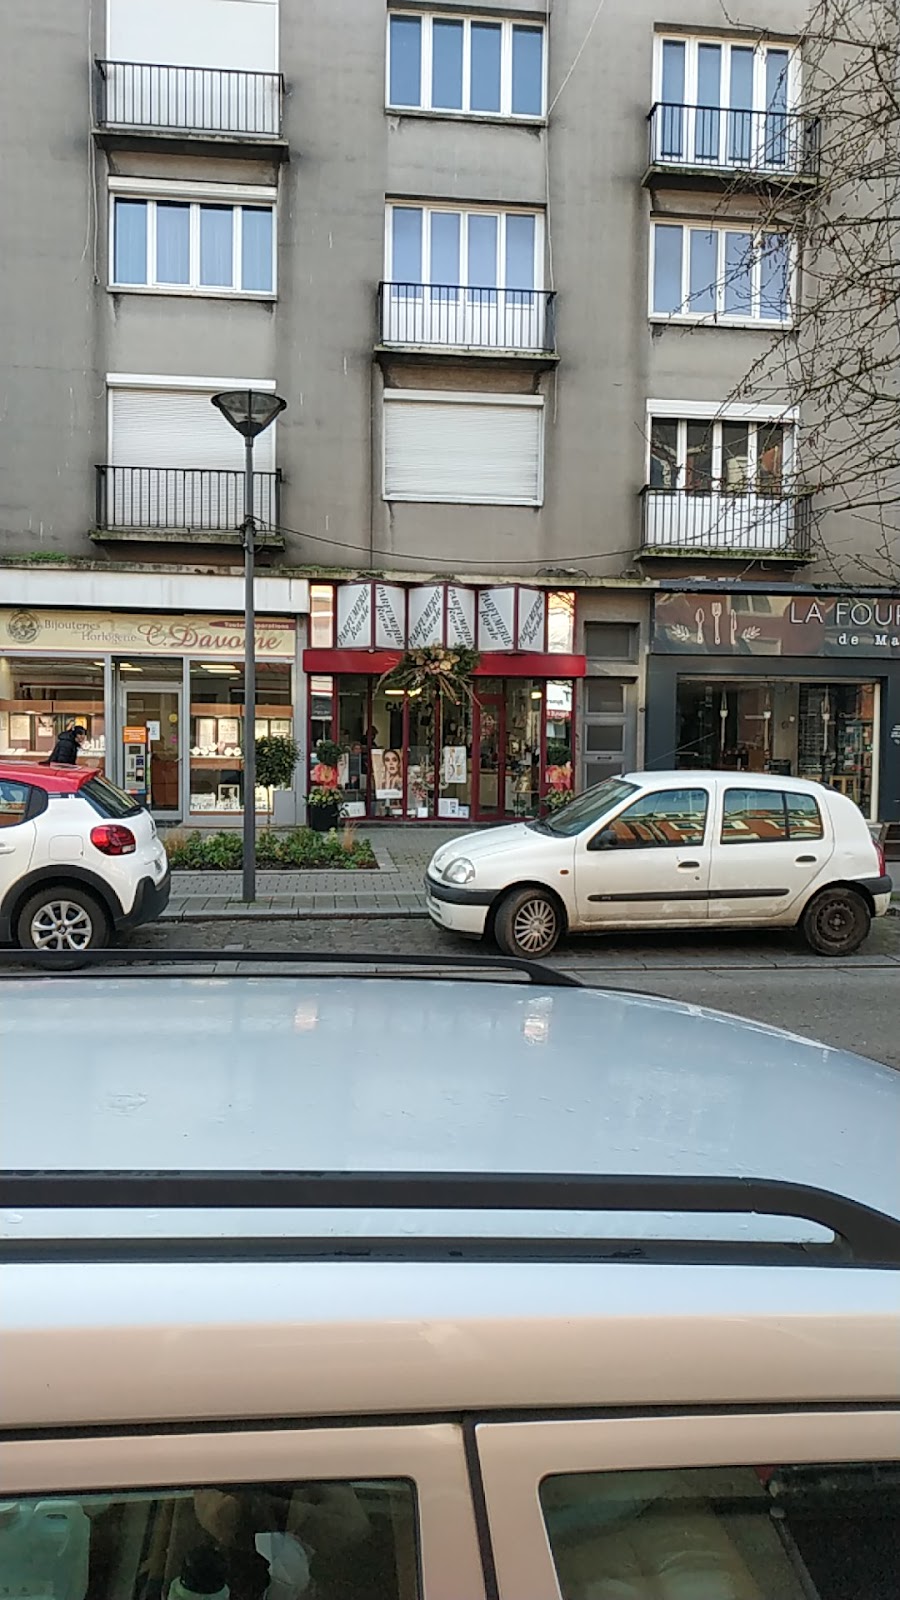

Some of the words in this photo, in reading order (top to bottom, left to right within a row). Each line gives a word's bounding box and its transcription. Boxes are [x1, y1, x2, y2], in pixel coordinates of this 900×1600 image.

[337, 585, 370, 646] PARFUMERIE
[375, 605, 393, 638] Royale
[376, 587, 405, 646] PARFUMERIE
[408, 586, 442, 647] PARFUMERIE
[446, 607, 463, 640] Royale
[448, 588, 474, 648] PARFUMERIE
[479, 591, 514, 646] PARFUMERIE
[479, 610, 498, 641] Royale
[790, 601, 824, 624] LA
[81, 631, 137, 644] Horlogerie
[838, 632, 859, 646] de
